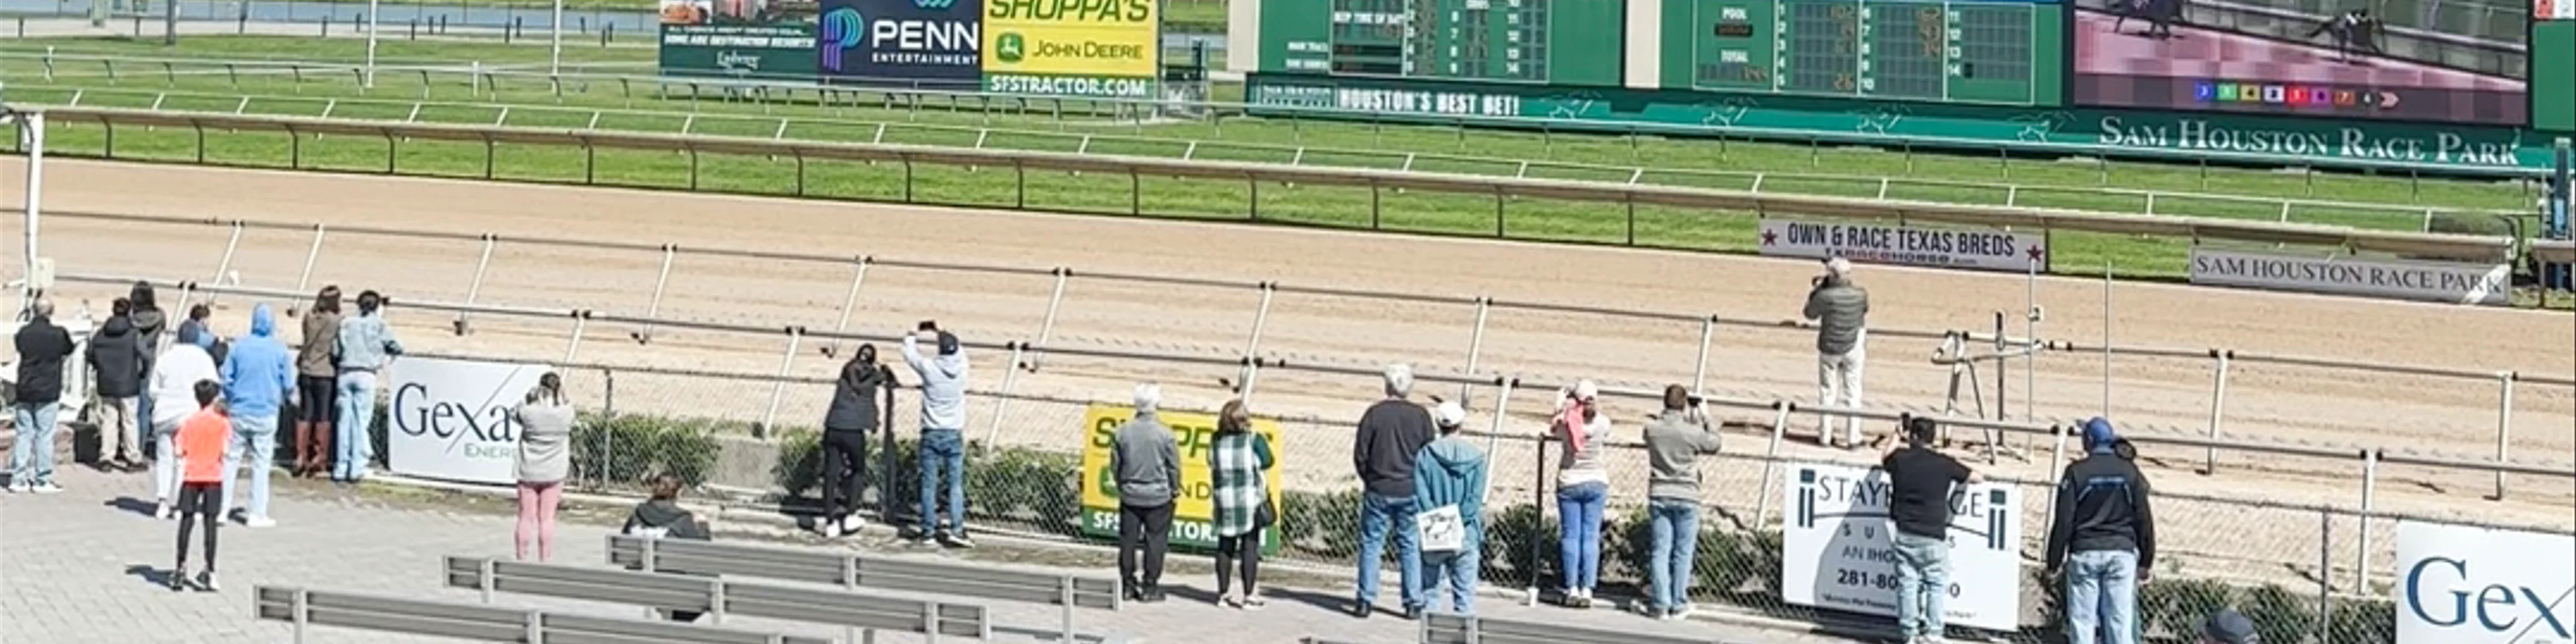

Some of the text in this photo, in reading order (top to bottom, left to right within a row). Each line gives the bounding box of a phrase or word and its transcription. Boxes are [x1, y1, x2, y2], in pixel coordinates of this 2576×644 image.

[873, 19, 978, 50] PENN
[1032, 40, 1143, 60] JOHN DEERE
[872, 52, 978, 64] ENTERTAINMENT
[991, 75, 1146, 96] SFSTRACTOR.COM
[1339, 88, 1432, 112] HOUSTON'S
[1436, 93, 1477, 113] BEST
[1482, 95, 1520, 115] BET!
[2100, 115, 2519, 165] SAM HOUSTON RACE PARK
[1787, 222, 2015, 257] OWN & RACE TEXAS BREDS
[2196, 256, 2502, 294] SAM HOUSTON RACE PARK
[395, 382, 515, 443] Gexa
[464, 443, 519, 459] ENER
[2406, 555, 2575, 641] Gex
